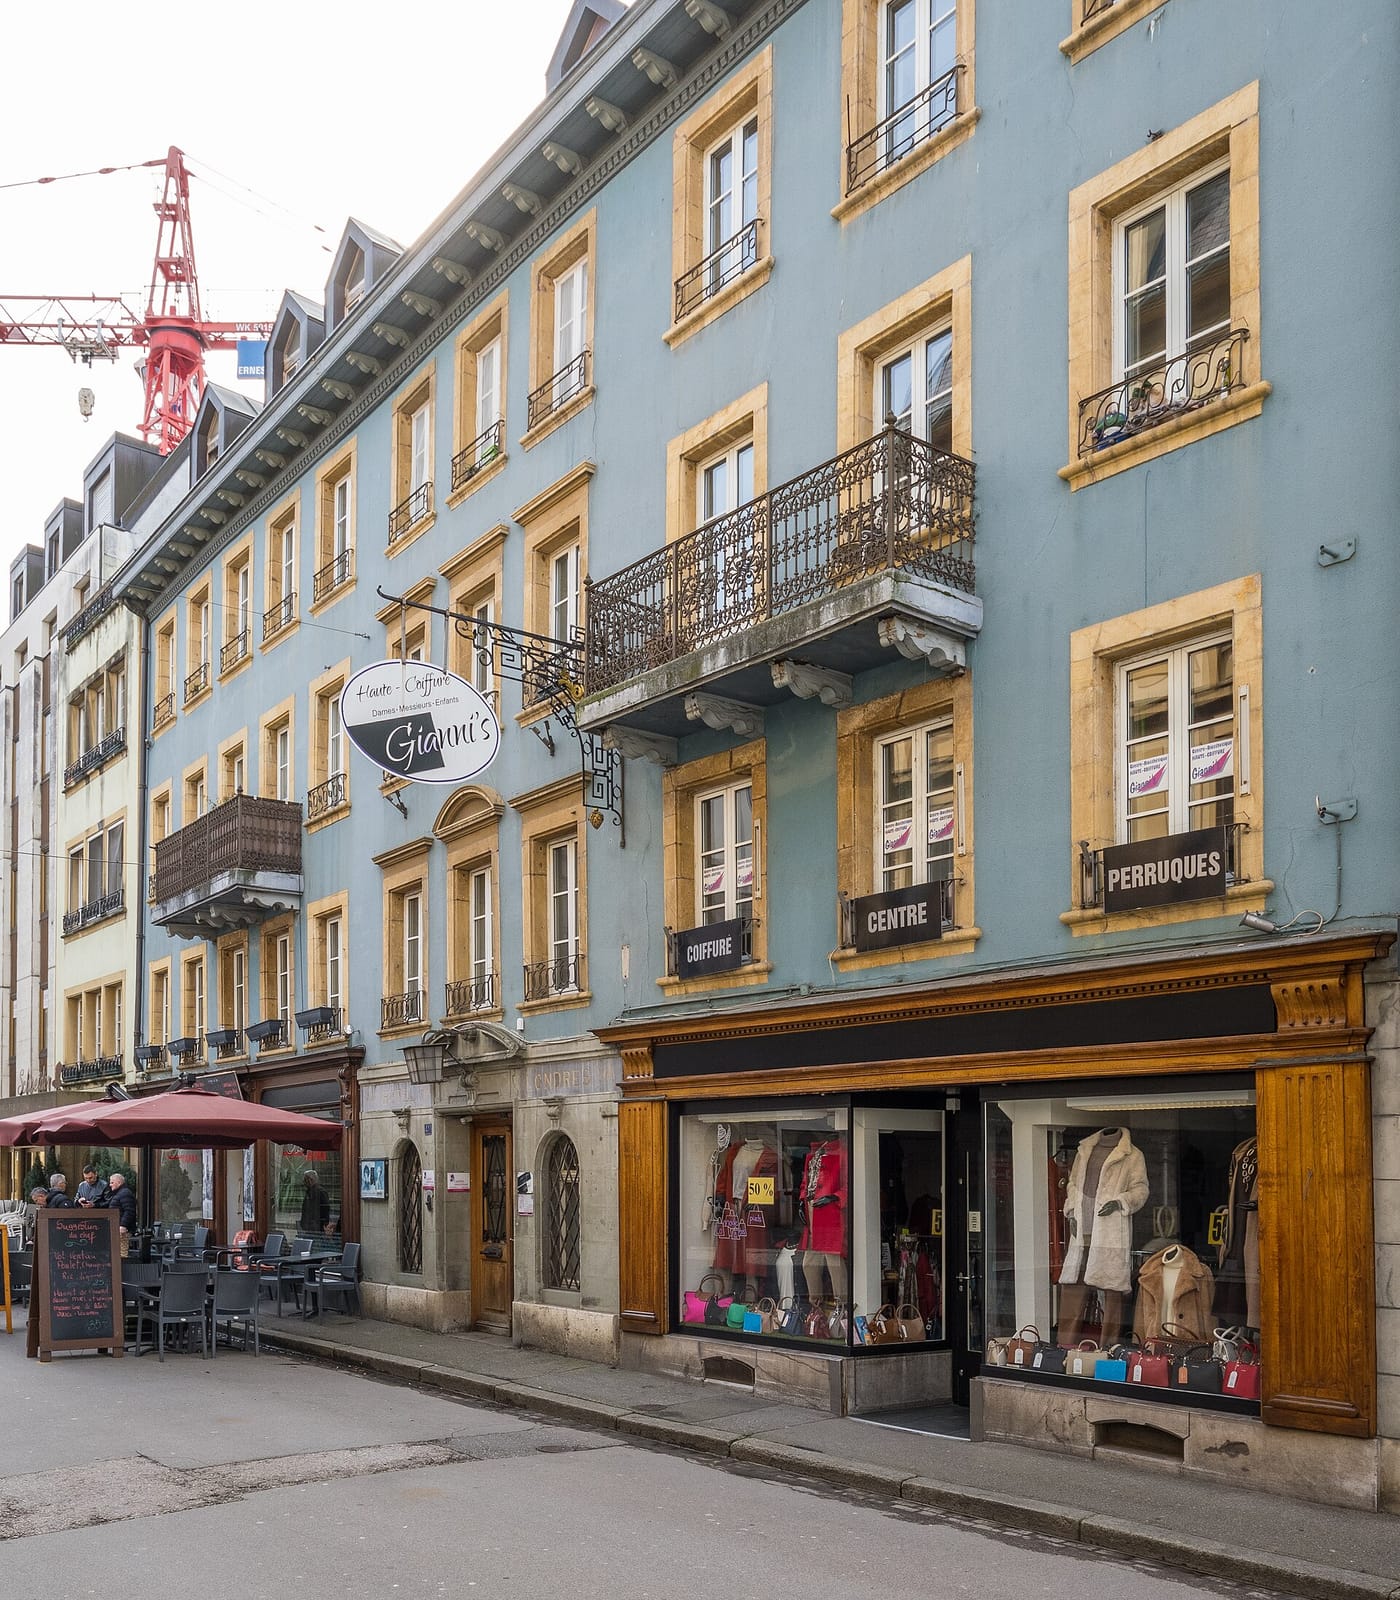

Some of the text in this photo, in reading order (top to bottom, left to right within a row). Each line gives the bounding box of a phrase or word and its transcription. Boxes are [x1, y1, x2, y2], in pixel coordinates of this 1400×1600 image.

[236, 323, 251, 331] WK
[356, 683, 393, 702] Haute
[404, 672, 451, 697] Coiffure
[386, 711, 490, 771] Gianni's
[1108, 851, 1221, 892] PERRUQUES
[867, 902, 927, 933] CENTRE
[749, 1182, 774, 1196] 50 %
